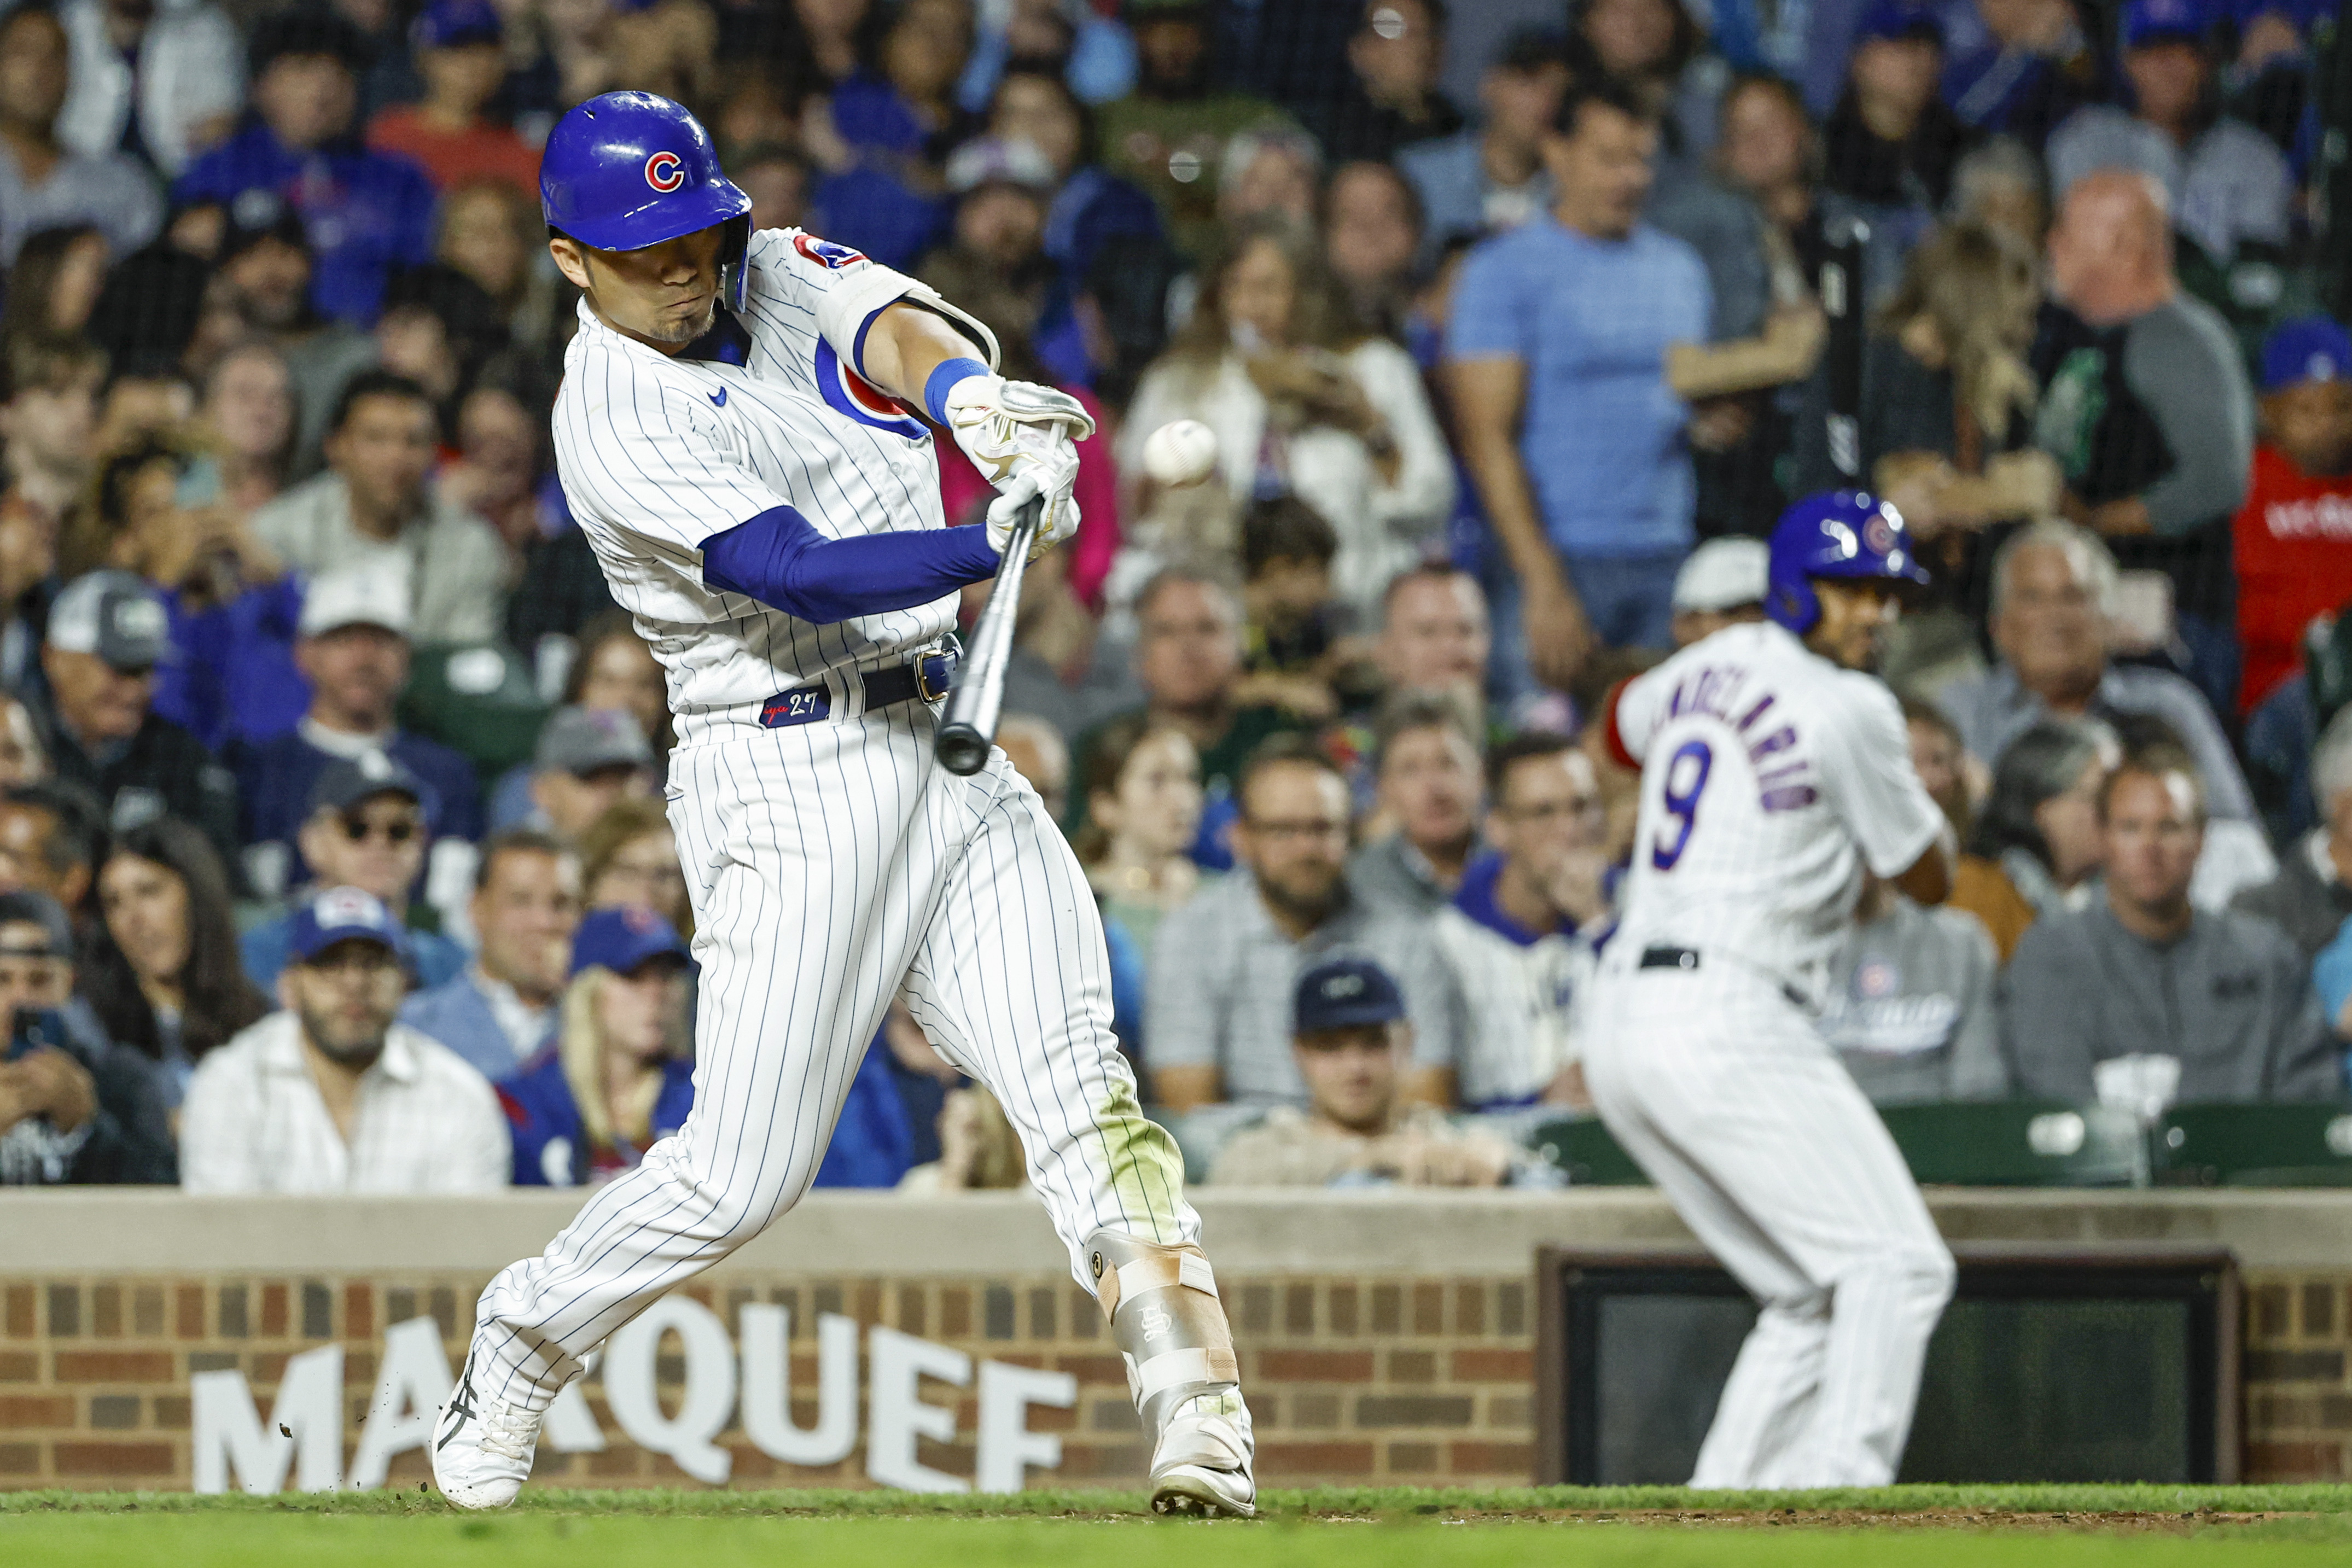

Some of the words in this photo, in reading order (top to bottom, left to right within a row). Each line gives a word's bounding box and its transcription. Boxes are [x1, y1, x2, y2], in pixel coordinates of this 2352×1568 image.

[644, 151, 684, 193] C
[763, 704, 789, 725] iya
[789, 692, 818, 717] 27
[1653, 739, 1712, 872] 9
